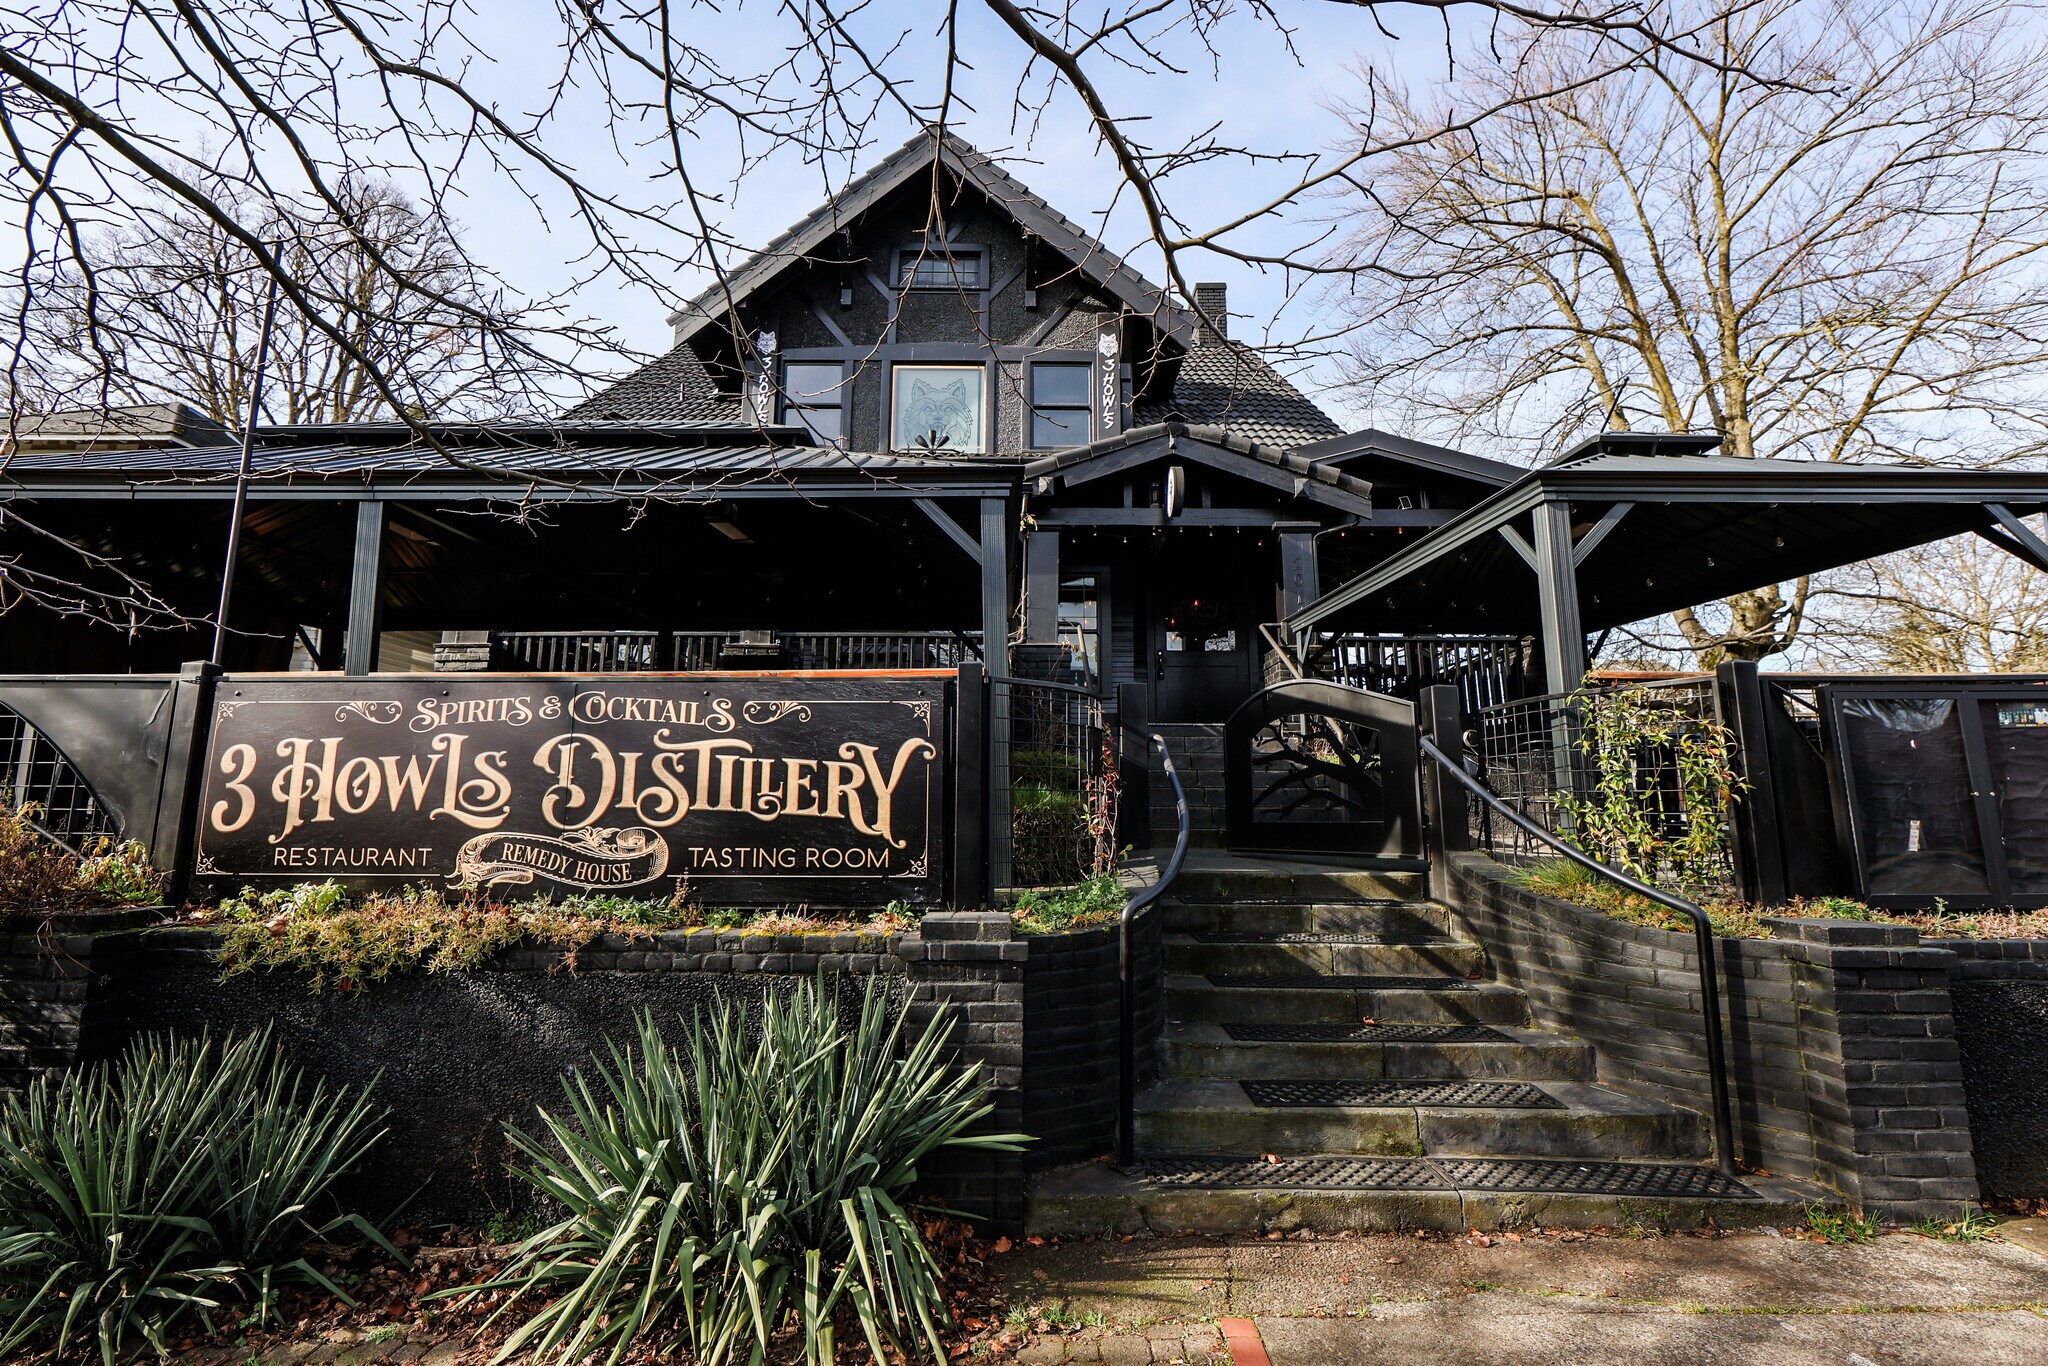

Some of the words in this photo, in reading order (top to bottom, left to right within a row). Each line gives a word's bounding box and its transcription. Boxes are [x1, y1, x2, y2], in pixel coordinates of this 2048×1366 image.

[1102, 358, 1116, 371] 3
[1102, 372, 1116, 430] HOWLS
[409, 696, 533, 733] SPIRITS
[538, 695, 562, 720] &
[568, 690, 736, 733] COCKTAILS
[210, 743, 258, 833] 3
[268, 733, 512, 845] HOWLS
[532, 728, 937, 850] DISTILLERY
[273, 847, 433, 867] RESTAURANT
[501, 842, 574, 875] REMEDY
[574, 860, 633, 883] HOUSE
[688, 847, 796, 868] TASTING
[804, 847, 890, 869] ROOM
